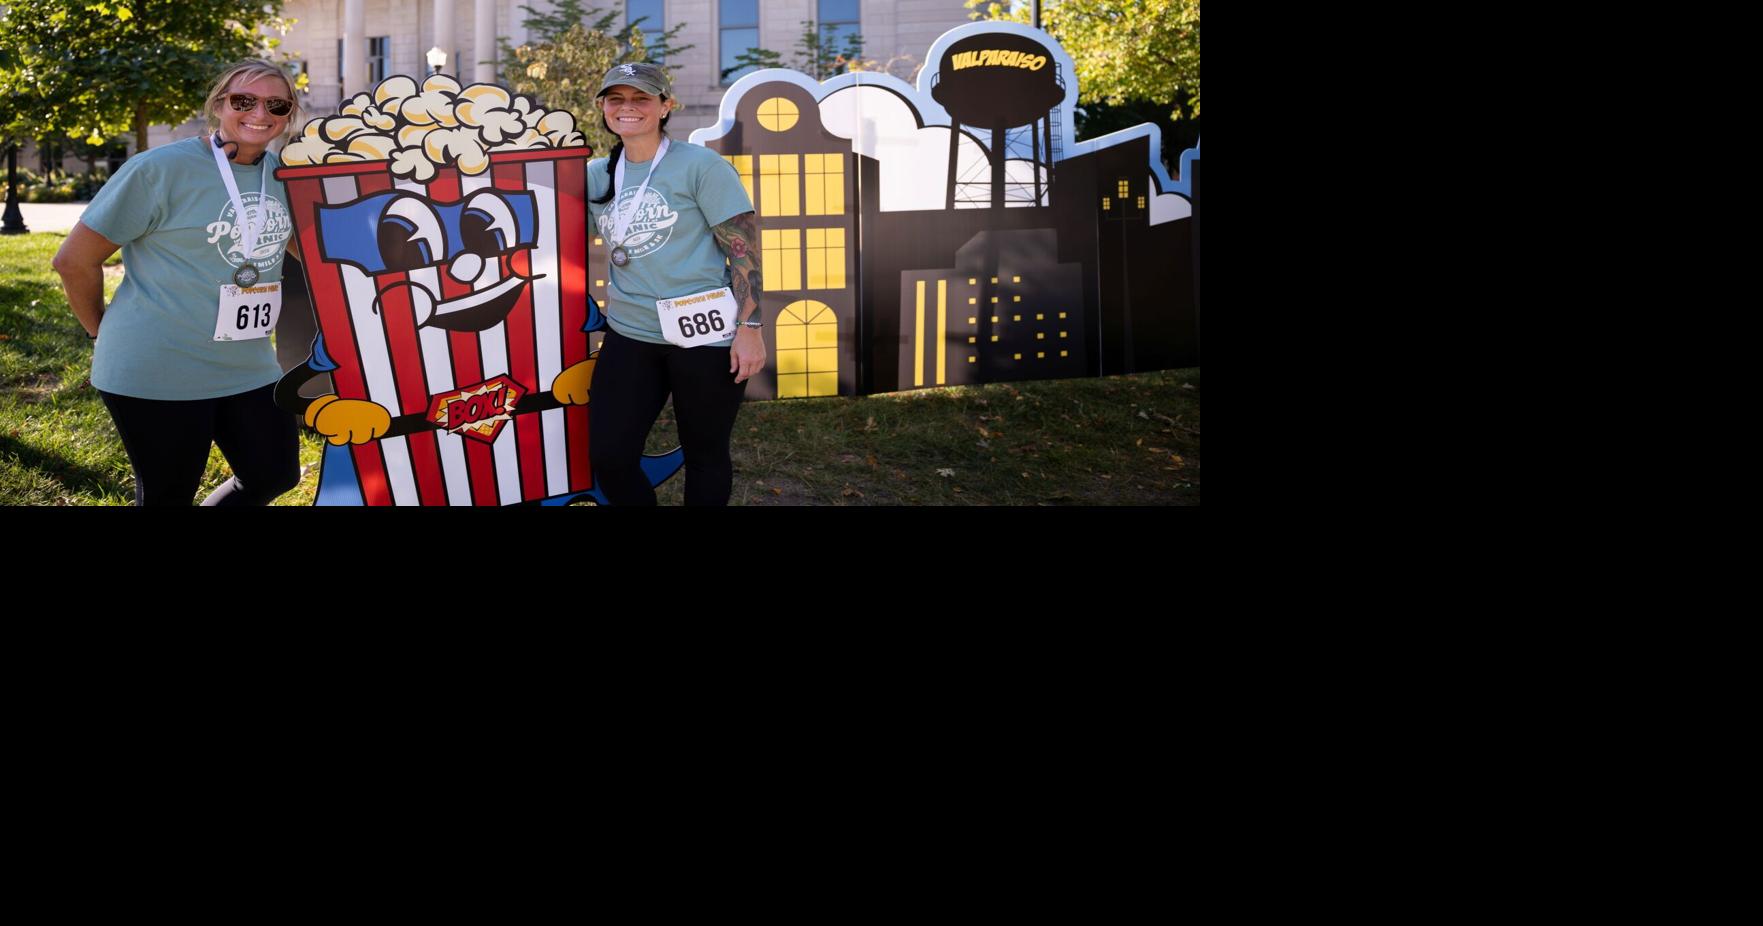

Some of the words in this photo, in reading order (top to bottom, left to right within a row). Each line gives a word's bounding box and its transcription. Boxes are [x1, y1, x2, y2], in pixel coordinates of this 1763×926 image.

[952, 50, 1046, 71] VALPARAISO
[206, 215, 291, 244] Poorn
[598, 204, 678, 234] Poorn
[625, 223, 657, 235] ANIC
[255, 233, 283, 245] ANIC
[236, 303, 271, 330] 613
[678, 309, 725, 338] 686
[447, 386, 508, 431] BOX!
